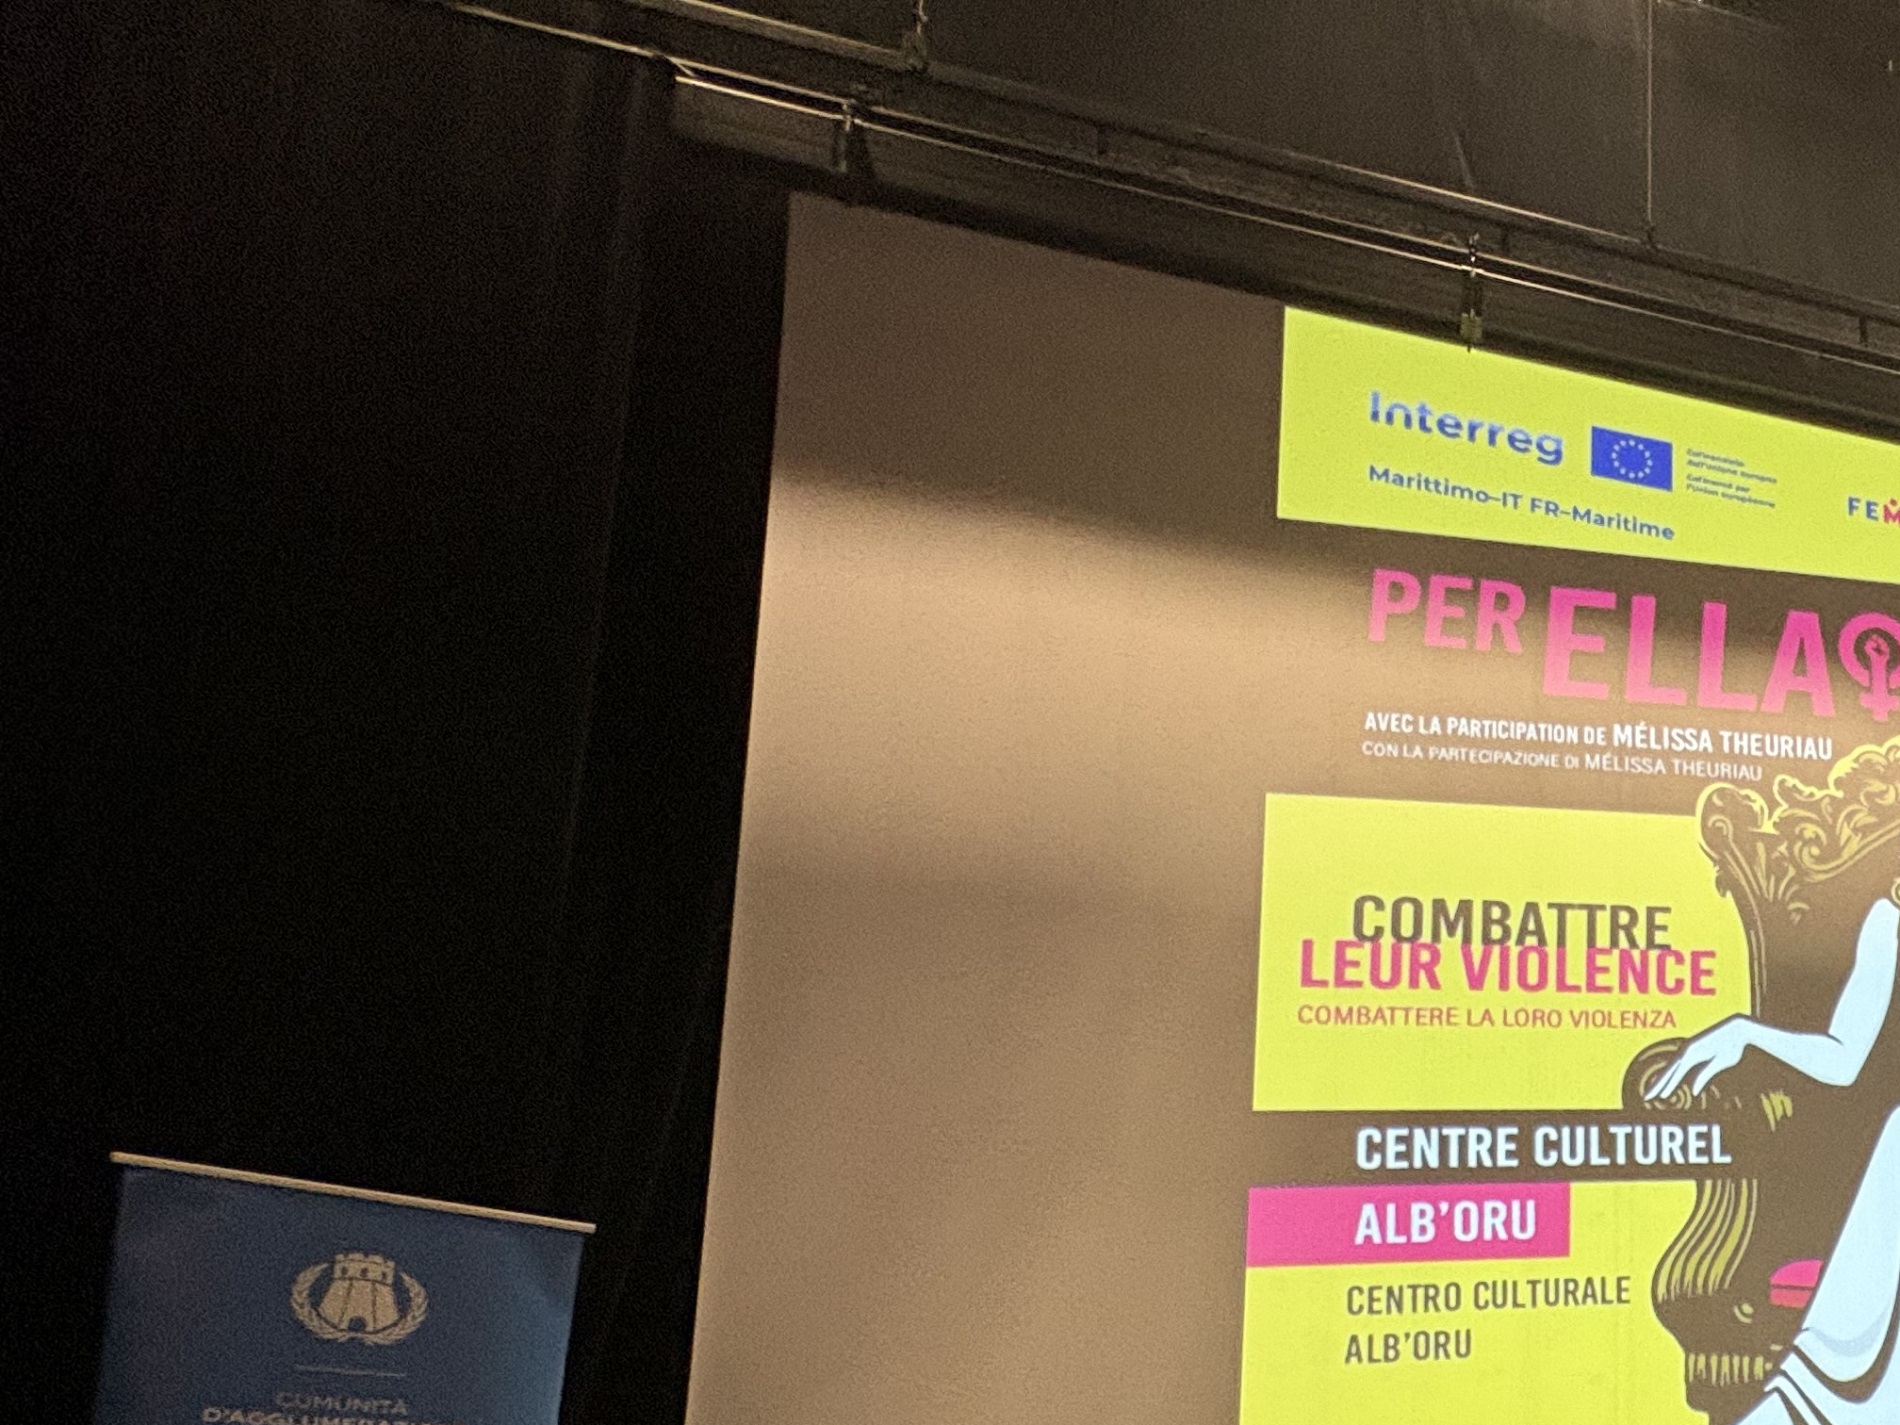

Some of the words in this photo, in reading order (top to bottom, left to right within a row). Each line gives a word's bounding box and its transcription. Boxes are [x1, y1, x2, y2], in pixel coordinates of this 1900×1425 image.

[1370, 390, 1563, 466] Interreg
[1367, 568, 1526, 653] PER
[1542, 585, 1836, 718] ELLA
[1364, 711, 1414, 733] AVEC
[1418, 715, 1442, 736] LA
[1446, 717, 1578, 744] PARTICIPATION
[1584, 726, 1606, 746] DE
[1612, 720, 1713, 754] MÉLISSA
[1719, 730, 1833, 760] THEURIAU
[1361, 740, 1398, 758] CON
[1403, 744, 1424, 760] LA
[1428, 746, 1560, 768] PARTECIPAZIONE
[1564, 754, 1579, 770] DI
[1585, 751, 1666, 775] MÉLISSA
[1673, 758, 1763, 782] THEURIAU
[1353, 894, 1672, 951] COMBATTRE
[1300, 938, 1441, 992] LEUR
[1461, 942, 1717, 996] VIOLENCE
[1297, 1003, 1458, 1027] COMBATTERE
[1466, 1006, 1495, 1028] LA
[1502, 1006, 1563, 1028] LORO
[1569, 1008, 1677, 1029] VIOLENZA
[1355, 1125, 1520, 1171] CENTRE
[1534, 1124, 1733, 1167] CULTUREL
[1354, 1199, 1538, 1246] ALB'ORU
[1347, 1281, 1462, 1317] CENTRO
[1473, 1275, 1631, 1312] CULTURALE
[1344, 1328, 1473, 1365] ALB'ORU
